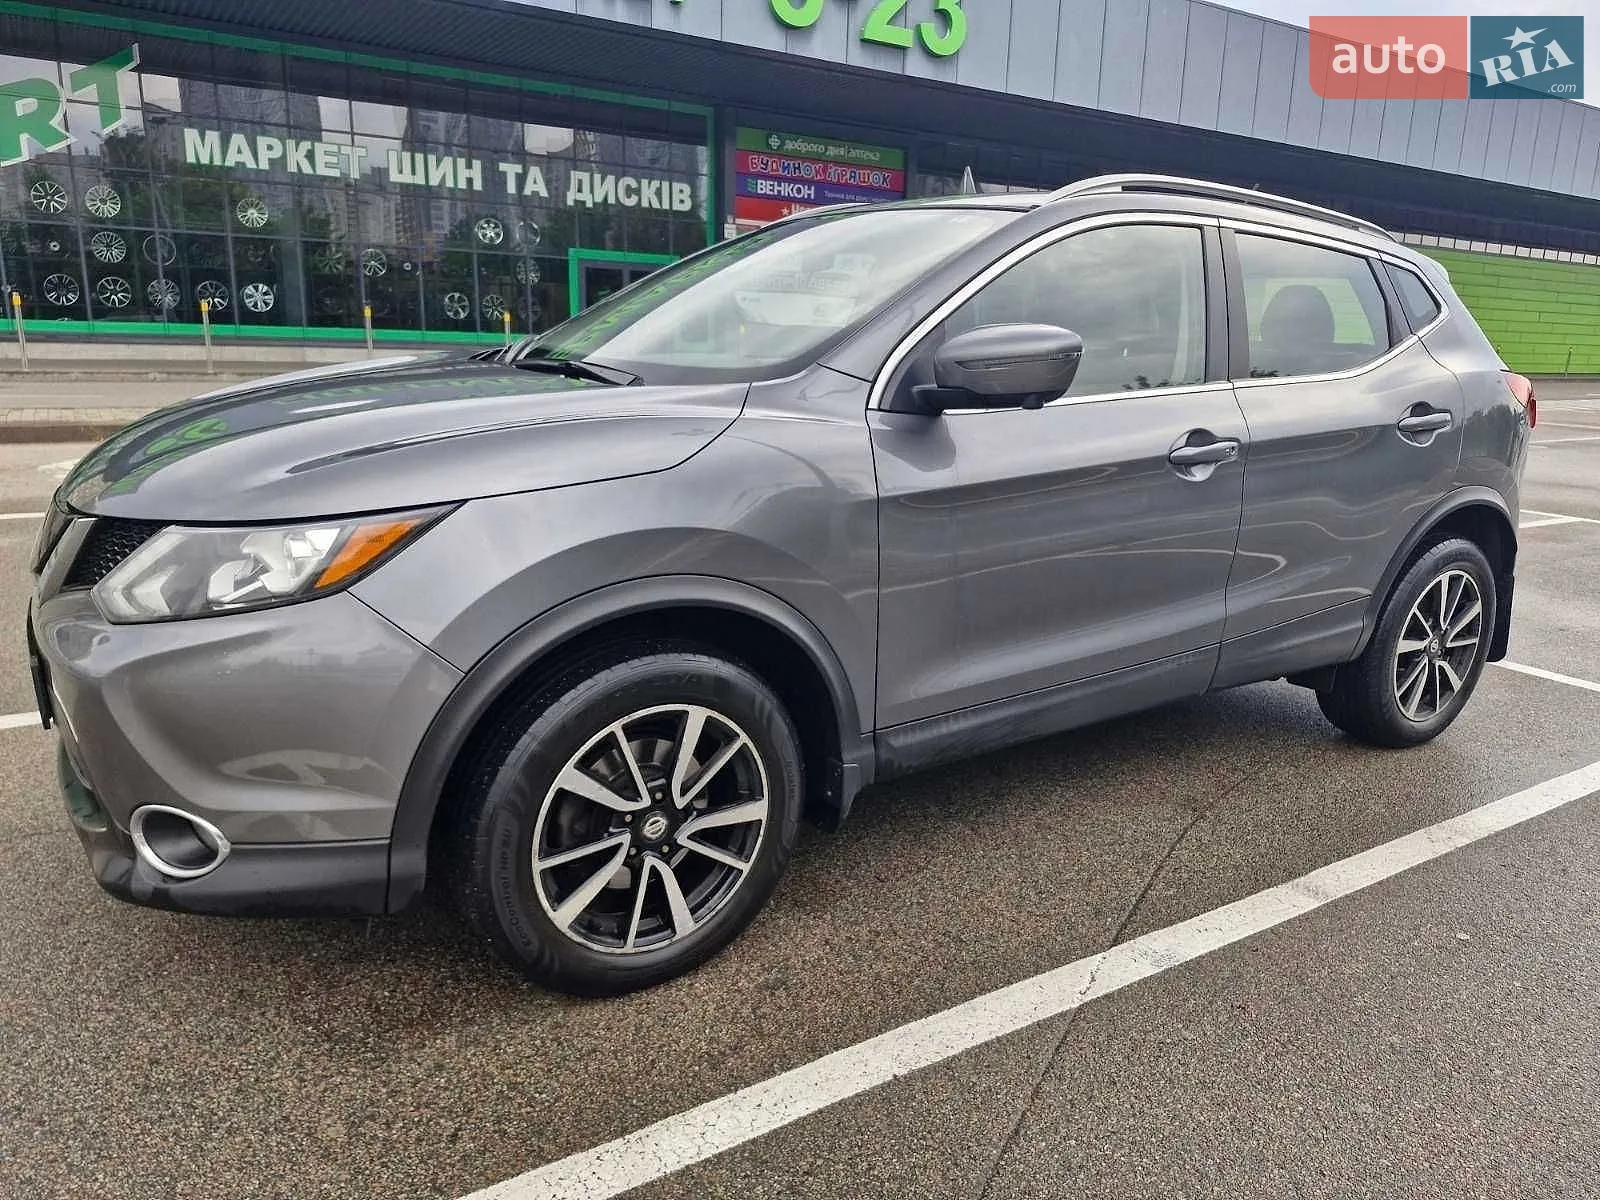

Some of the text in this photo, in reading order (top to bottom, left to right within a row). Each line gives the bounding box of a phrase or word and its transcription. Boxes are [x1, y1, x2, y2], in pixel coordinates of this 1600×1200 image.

[783, 138, 825, 154] доброго
[183, 127, 693, 212] МАРКЕТ ШИН ТА ДИСКІВ
[749, 156, 825, 180] БУДИНОК
[757, 179, 815, 199] ВЕНКОН
